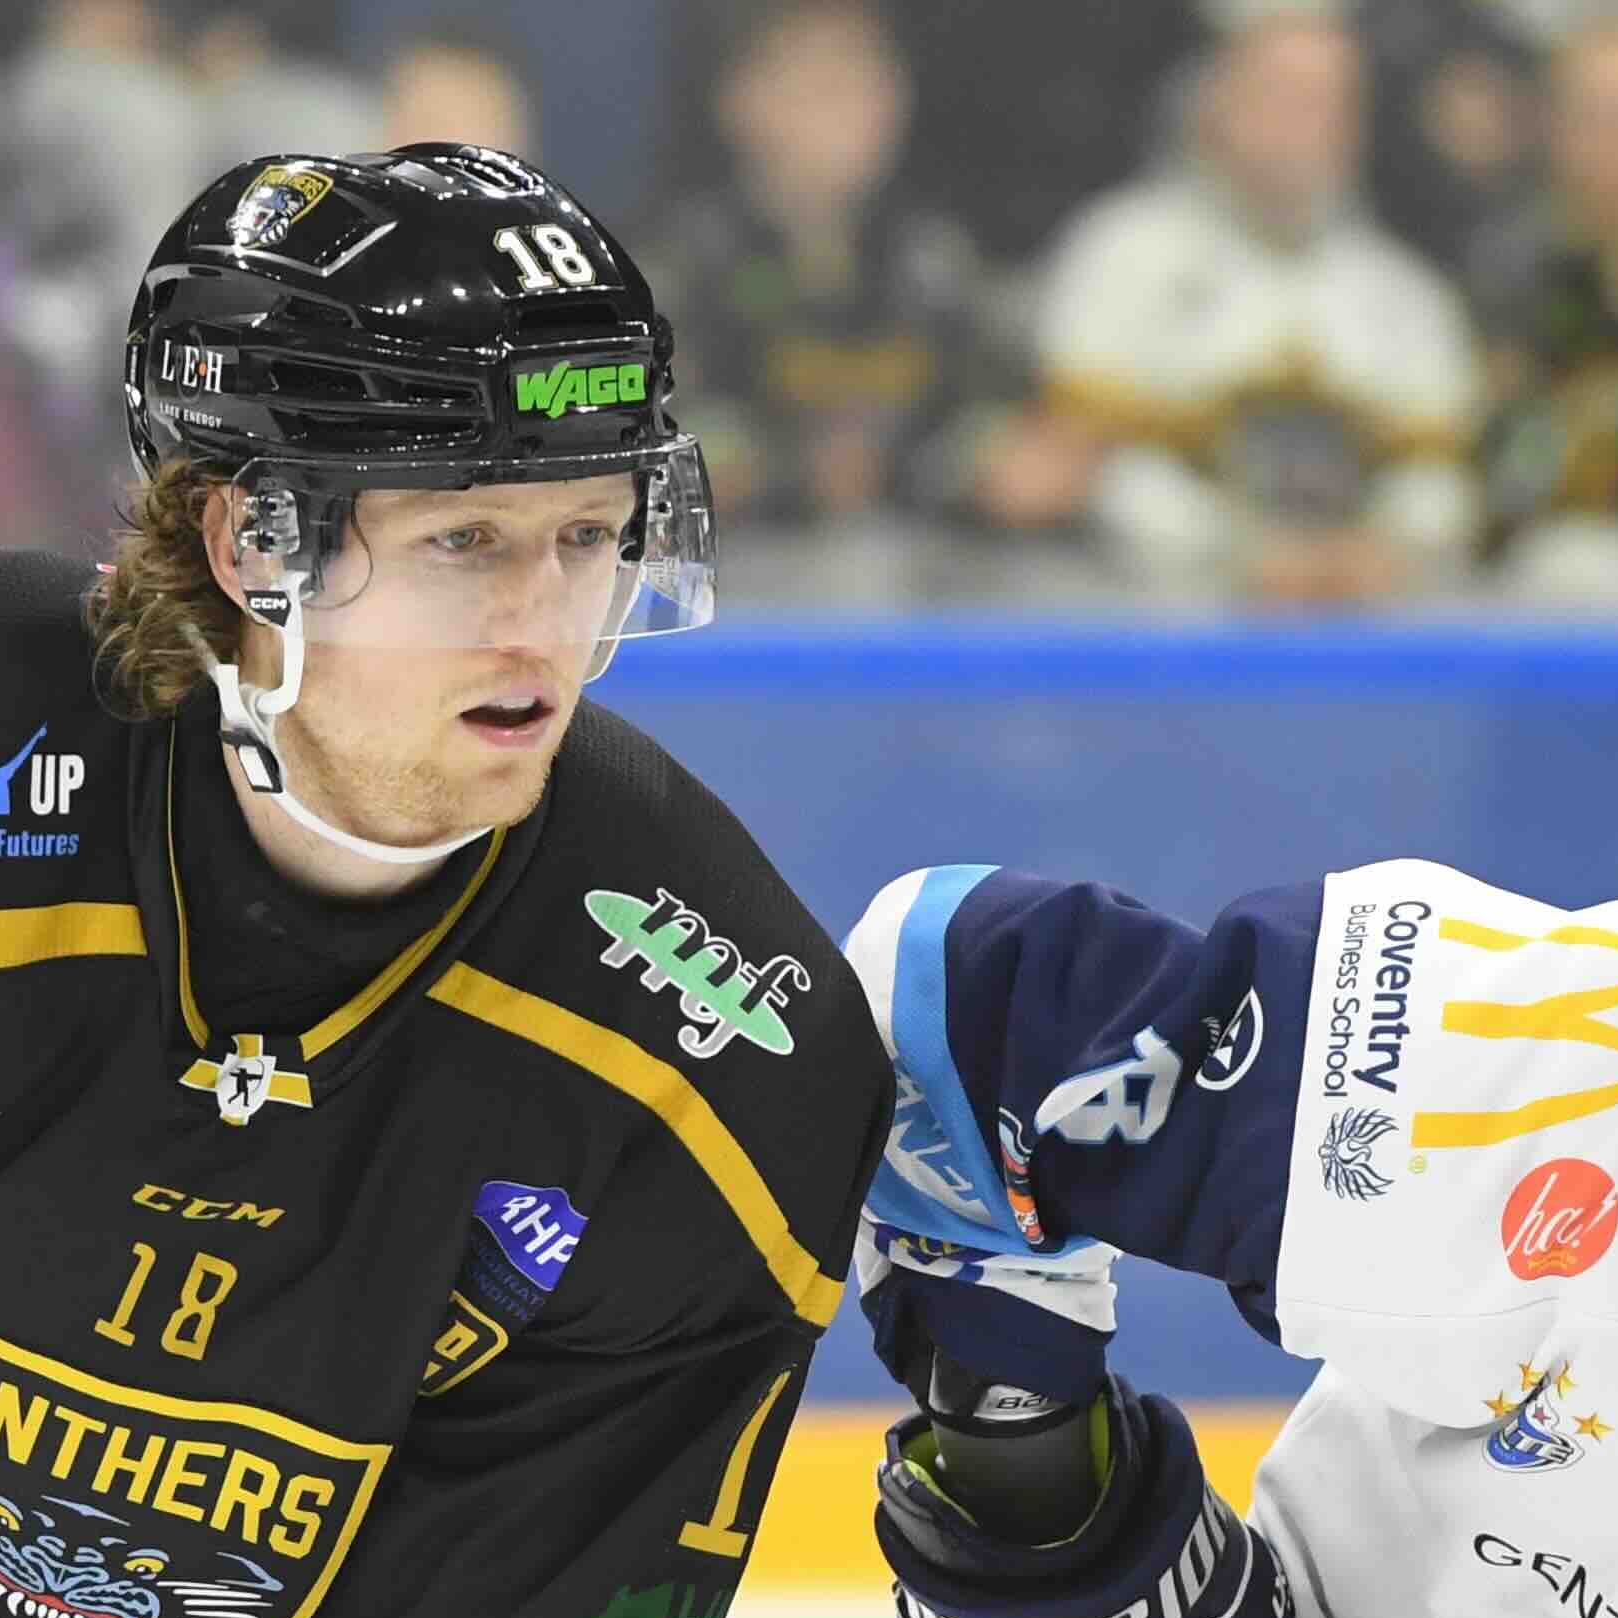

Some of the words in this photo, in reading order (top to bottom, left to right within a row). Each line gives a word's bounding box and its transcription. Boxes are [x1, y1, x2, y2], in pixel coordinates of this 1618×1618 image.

[493, 223, 596, 290] 18
[515, 360, 646, 419] WAGO
[250, 597, 288, 611] CCM
[29, 753, 86, 815] UP
[1334, 902, 1377, 993] Business
[1369, 900, 1432, 1095] Coventry
[1322, 997, 1362, 1098] School
[131, 1183, 286, 1229] CCM
[93, 1242, 239, 1362] 18
